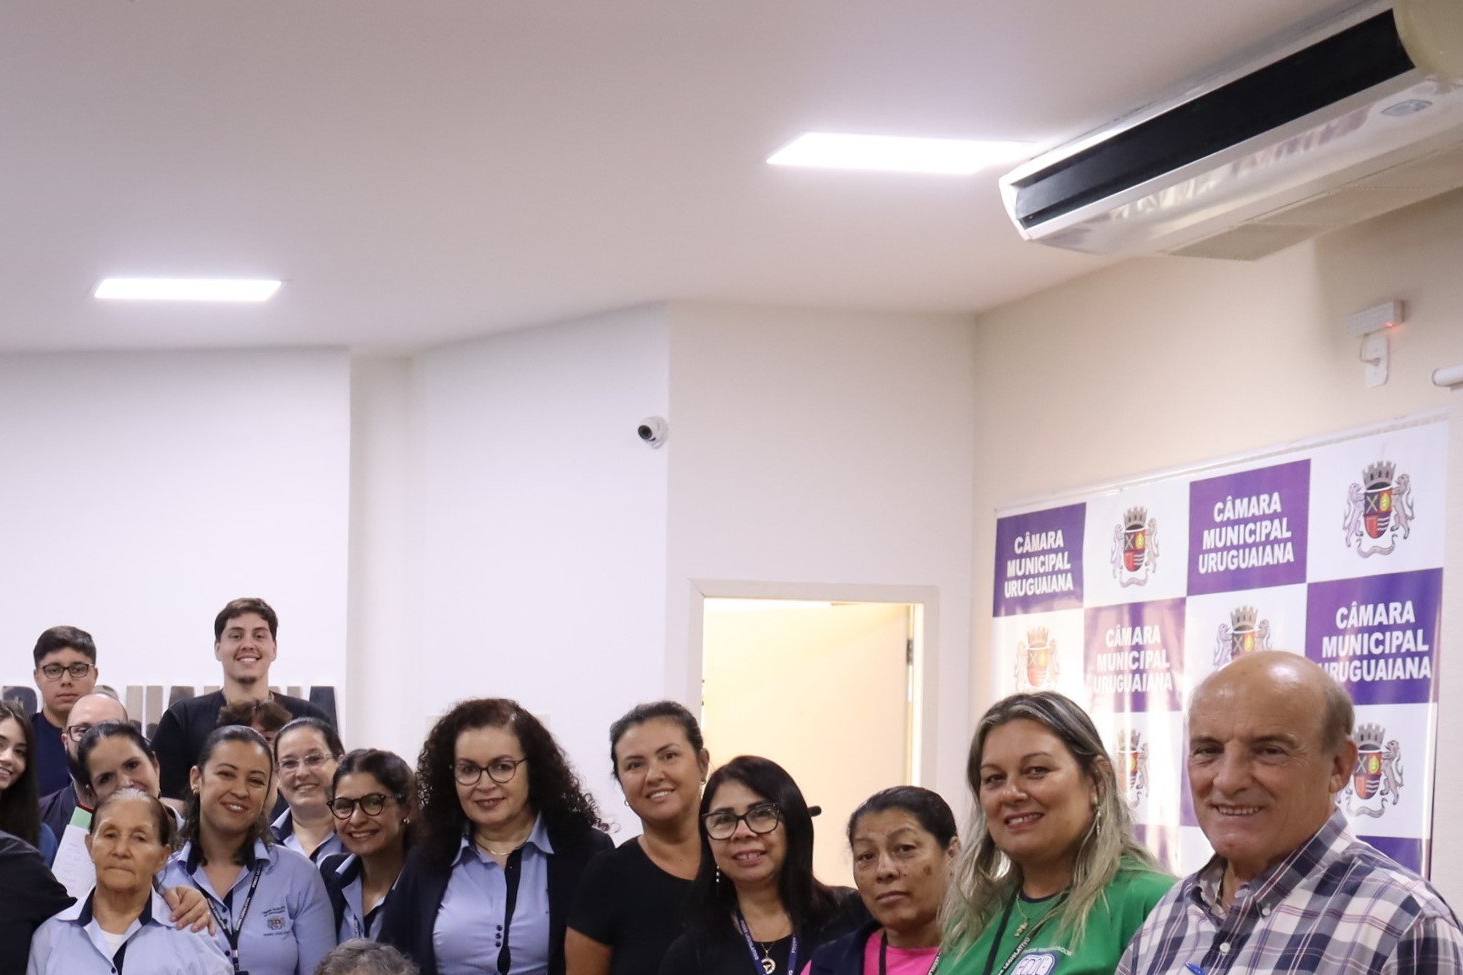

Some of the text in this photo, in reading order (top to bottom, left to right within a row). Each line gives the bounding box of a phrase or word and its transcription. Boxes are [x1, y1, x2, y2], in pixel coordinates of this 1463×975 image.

[1213, 491, 1282, 523] CÂMARA
[1014, 528, 1064, 555] CÂMARA
[1202, 516, 1293, 551] MUNICIPAL
[1006, 551, 1072, 578] MUNICIPAL
[1198, 541, 1295, 575] URUGUAIANA
[1004, 572, 1074, 599] URUGUAIANA
[1335, 600, 1416, 630] CÂMARA
[1105, 623, 1162, 648] CÂMARA
[1321, 628, 1430, 659] MUNICIPAL
[1096, 648, 1171, 673] MUNICIPAL
[1092, 671, 1174, 694] URUGUAIANA
